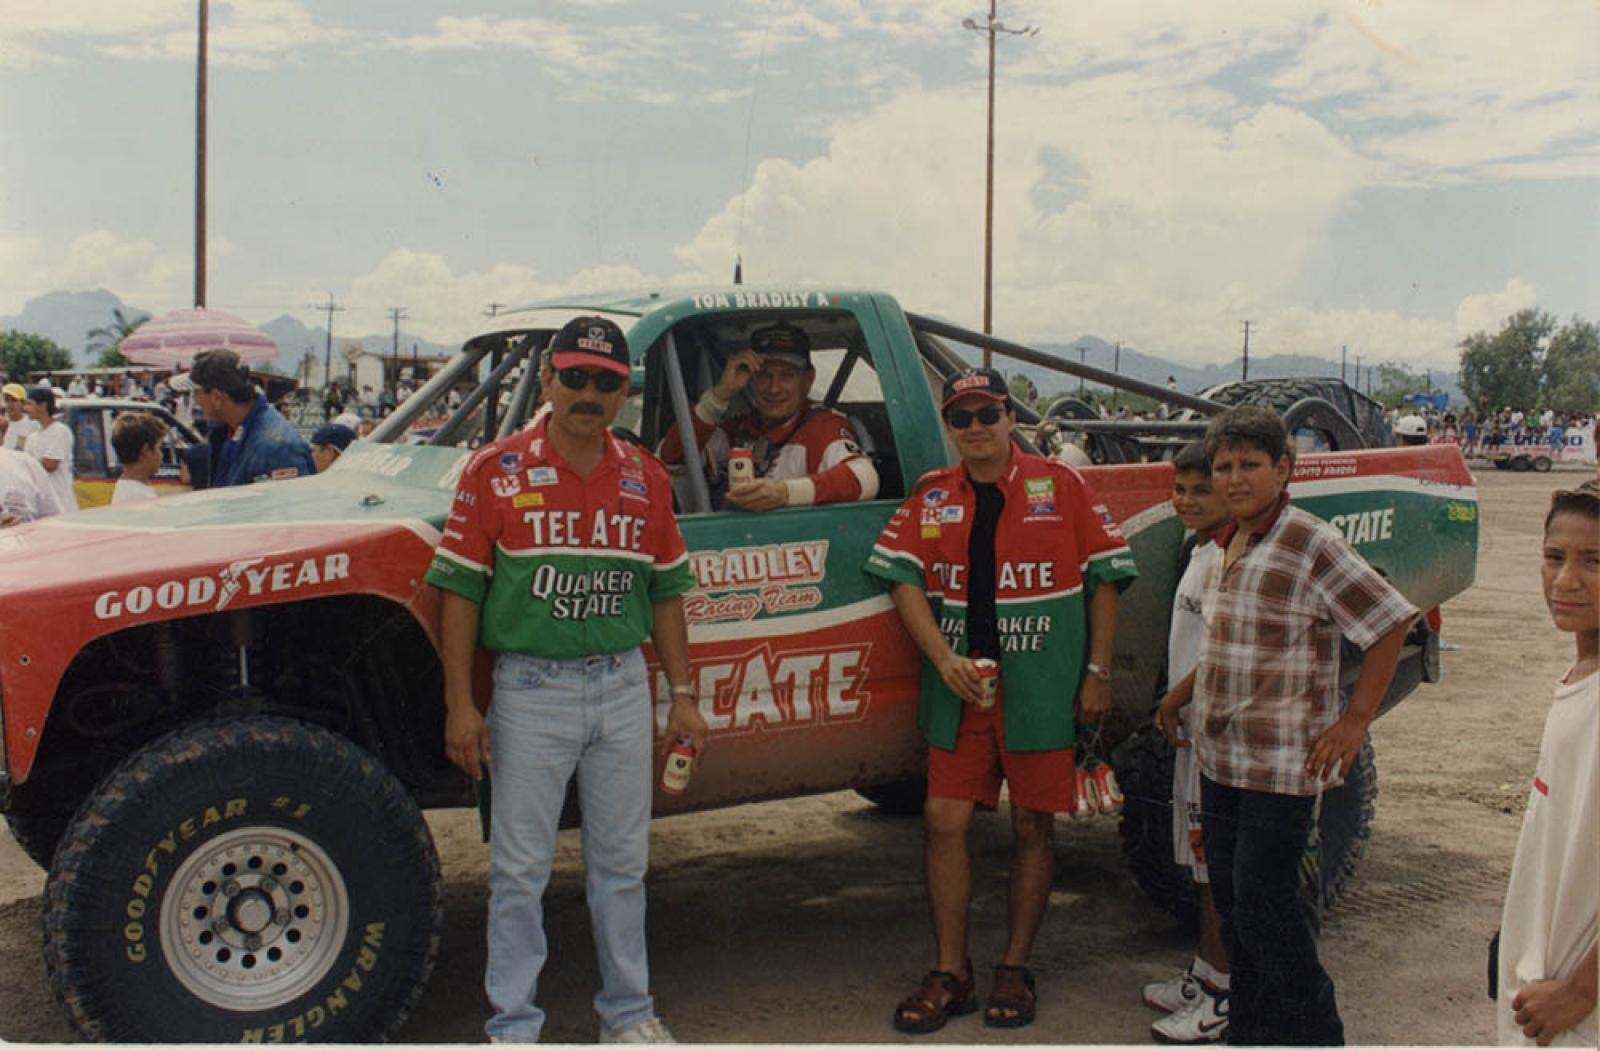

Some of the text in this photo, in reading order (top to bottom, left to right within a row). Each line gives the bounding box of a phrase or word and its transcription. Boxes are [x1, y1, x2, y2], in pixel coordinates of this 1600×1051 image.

[692, 294, 730, 309] TOM
[736, 292, 809, 308] BRADLEY
[552, 593, 624, 619] STATE
[684, 586, 819, 622] Racing Team
[240, 921, 385, 1043] WRANGLER
